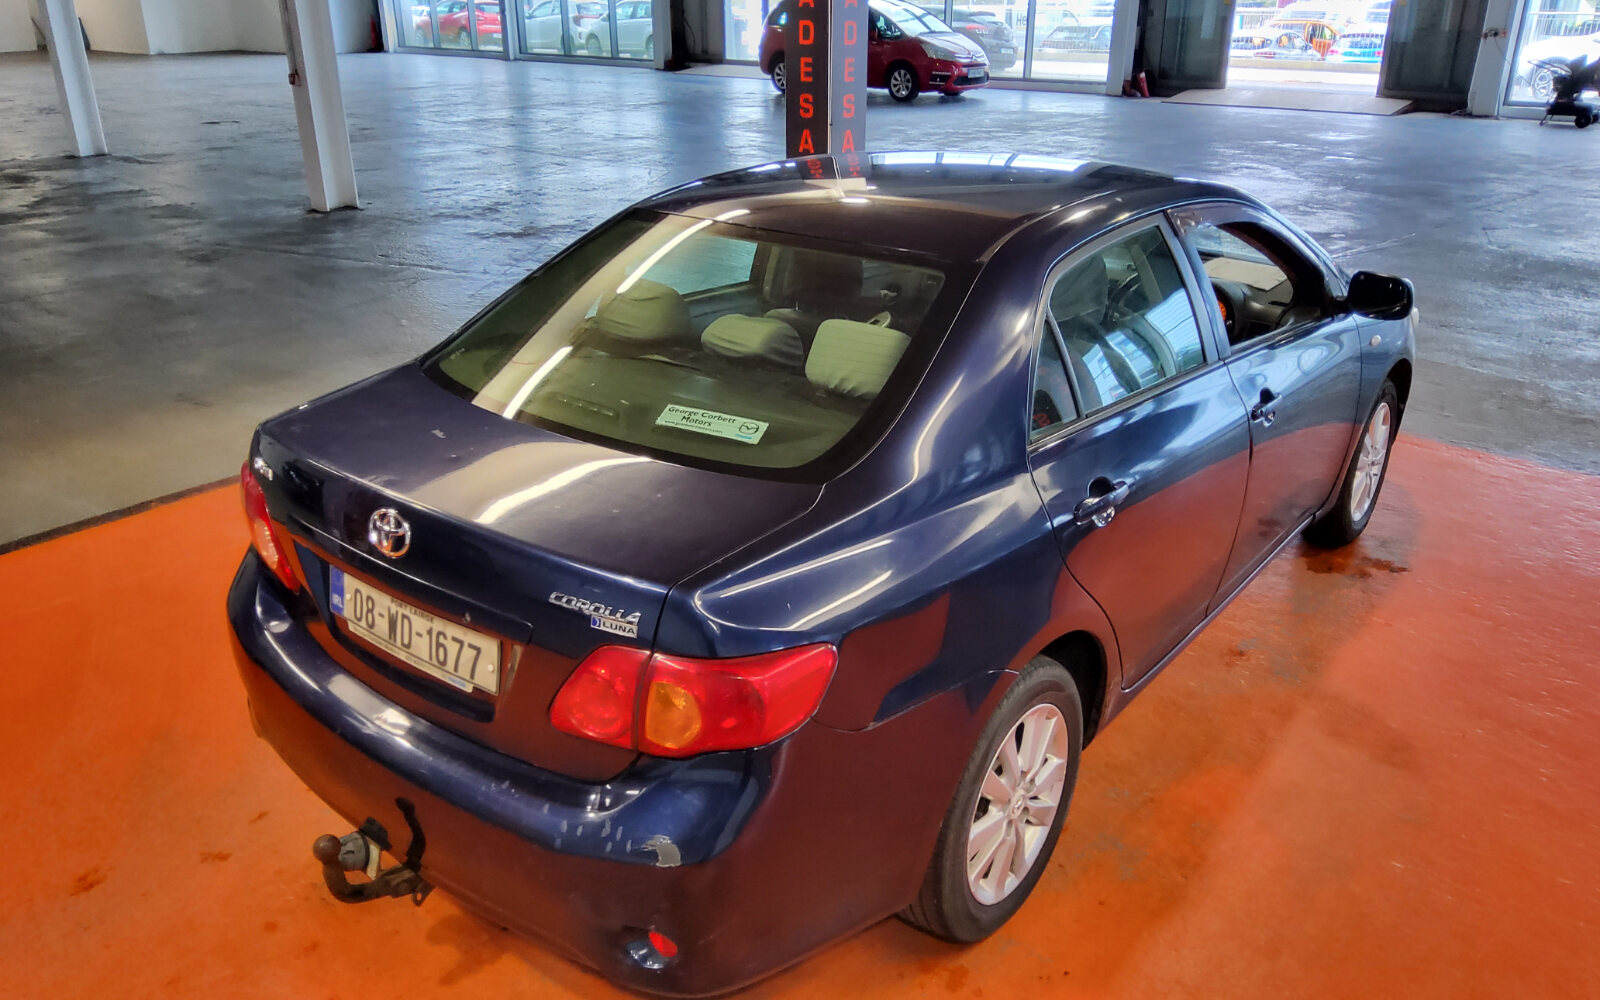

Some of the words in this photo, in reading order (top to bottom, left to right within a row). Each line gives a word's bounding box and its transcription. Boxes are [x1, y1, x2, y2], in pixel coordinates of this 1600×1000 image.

[668, 406, 699, 417] George
[701, 411, 737, 424] Corbett
[680, 416, 713, 427] Motors
[548, 591, 641, 626] COROLLA
[354, 588, 482, 681] 08-WD-1677
[602, 621, 636, 635] LUNA
